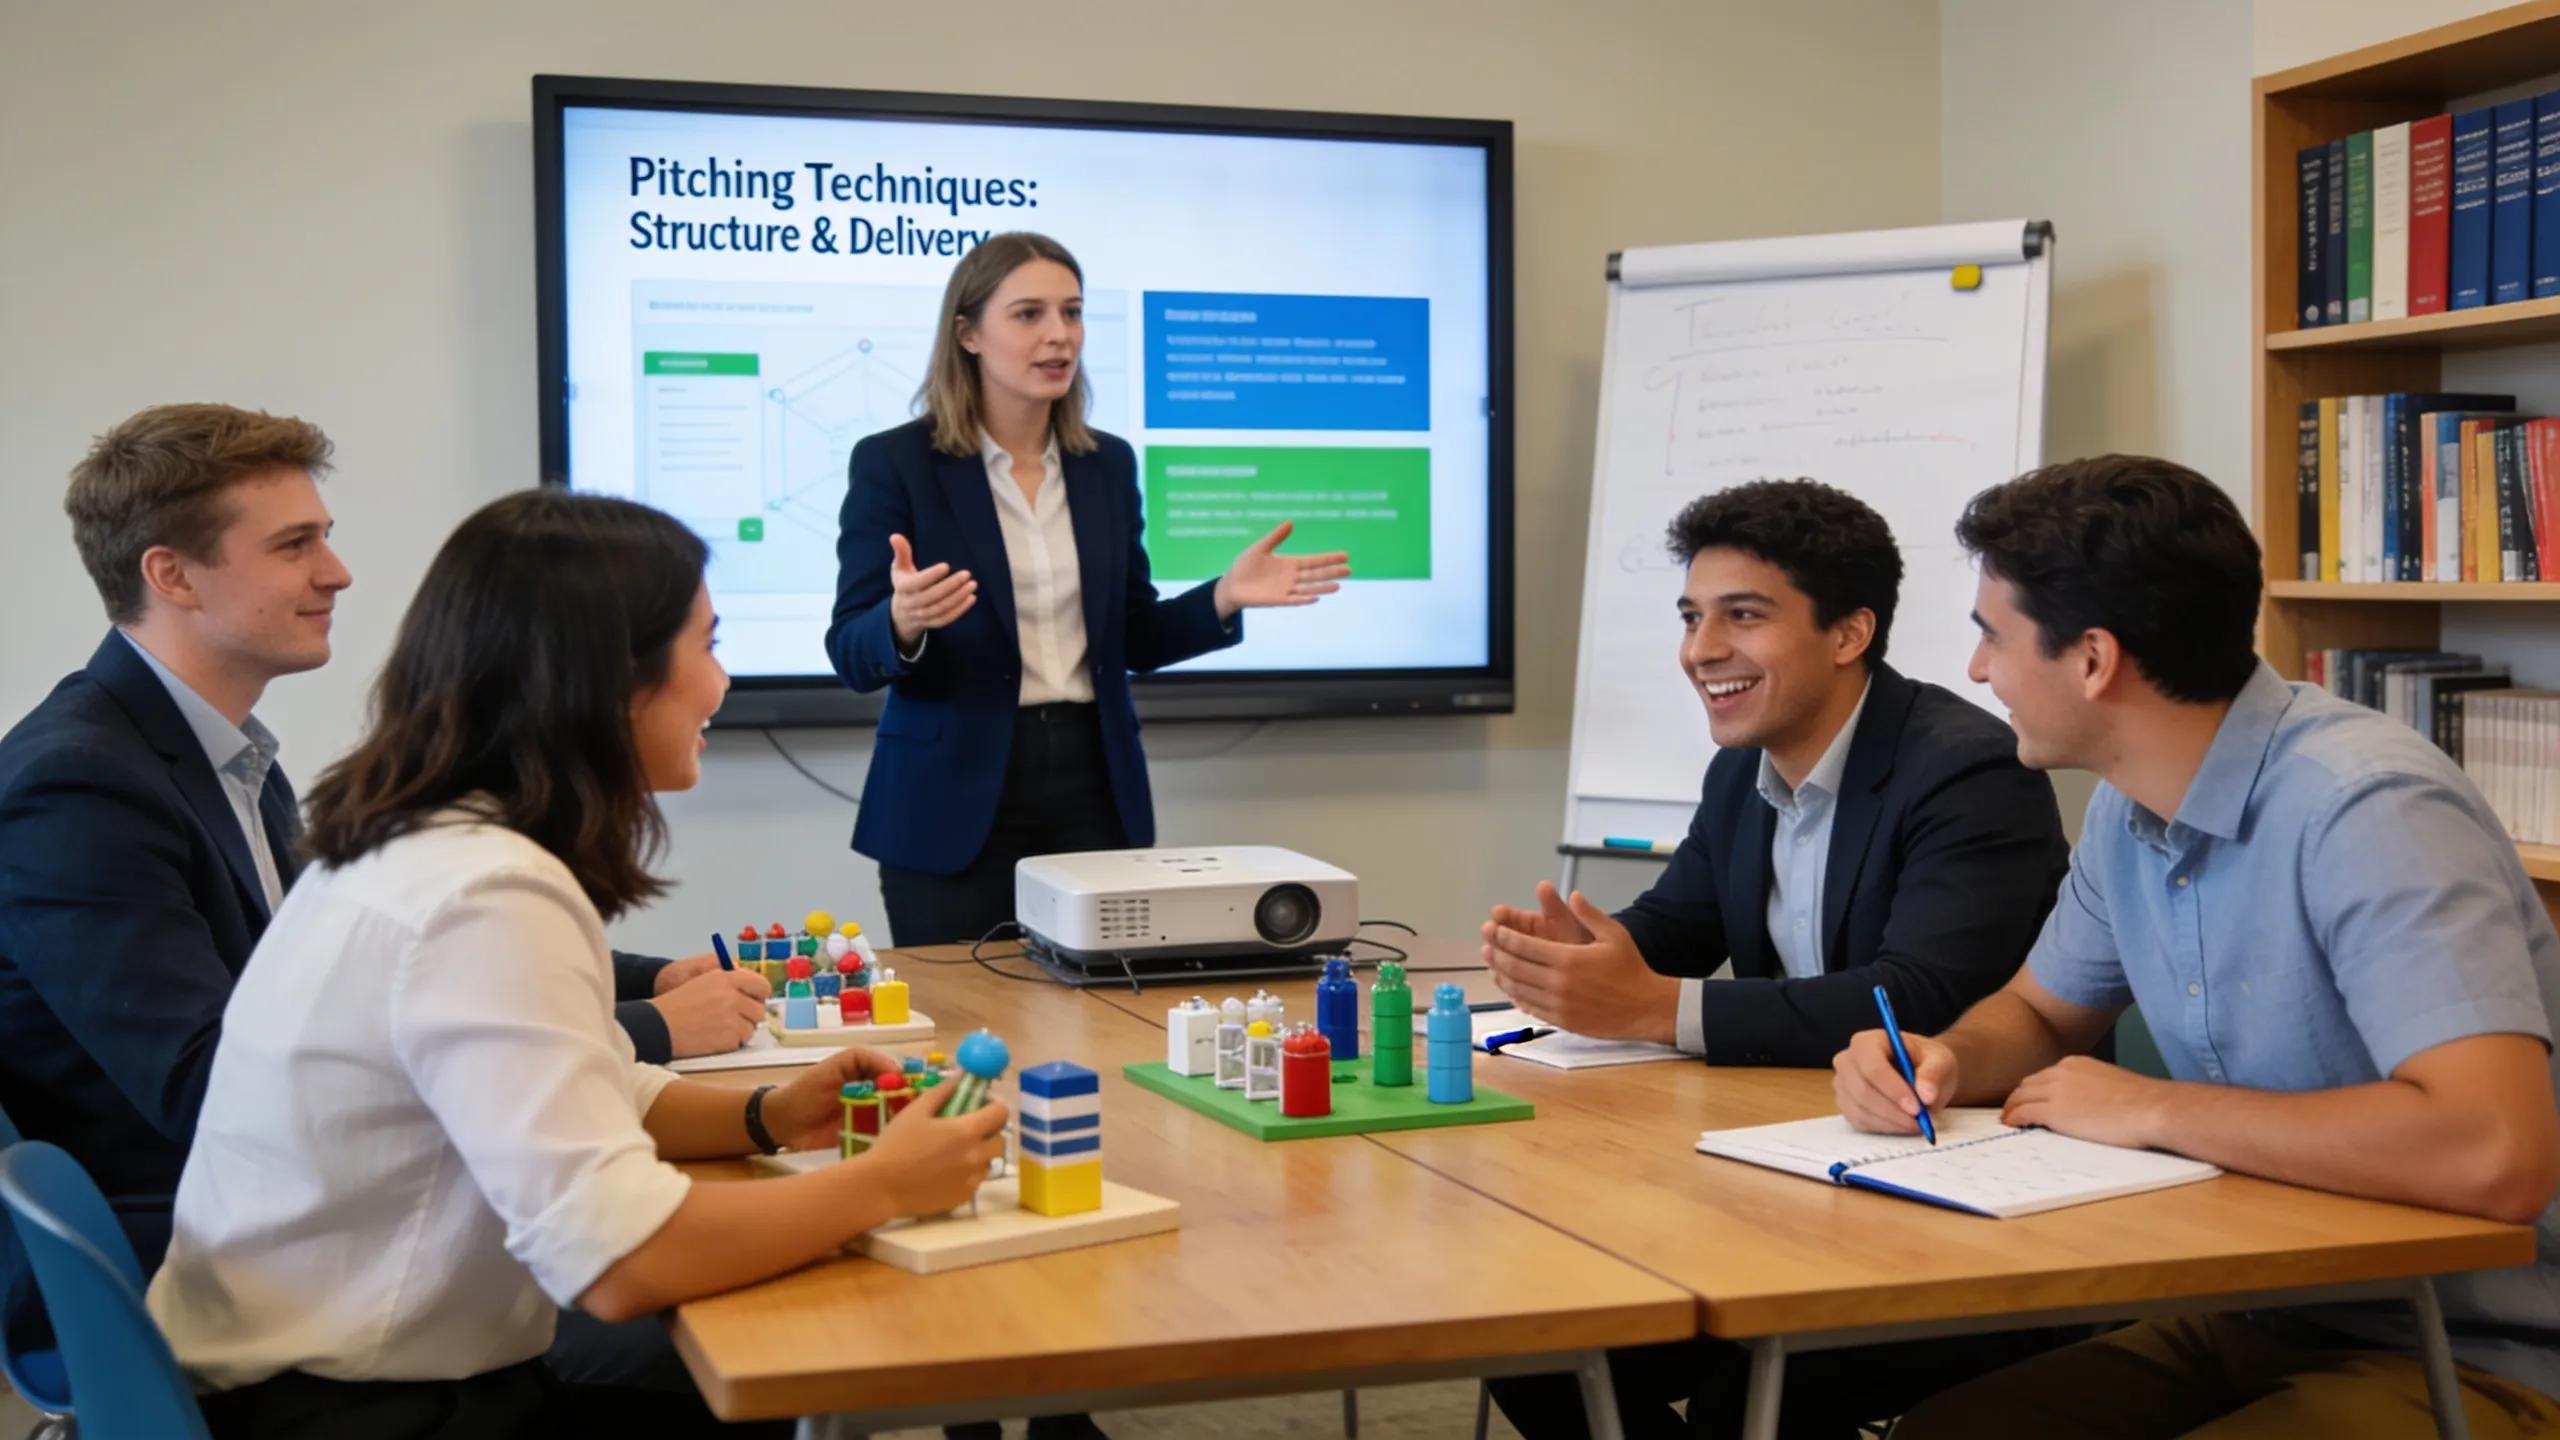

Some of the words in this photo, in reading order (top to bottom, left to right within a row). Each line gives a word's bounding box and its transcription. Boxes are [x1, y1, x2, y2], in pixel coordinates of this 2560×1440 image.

[629, 156, 796, 211] Pitching
[804, 162, 1038, 217] Techniques:
[630, 210, 801, 253] Structure
[811, 215, 840, 254] &
